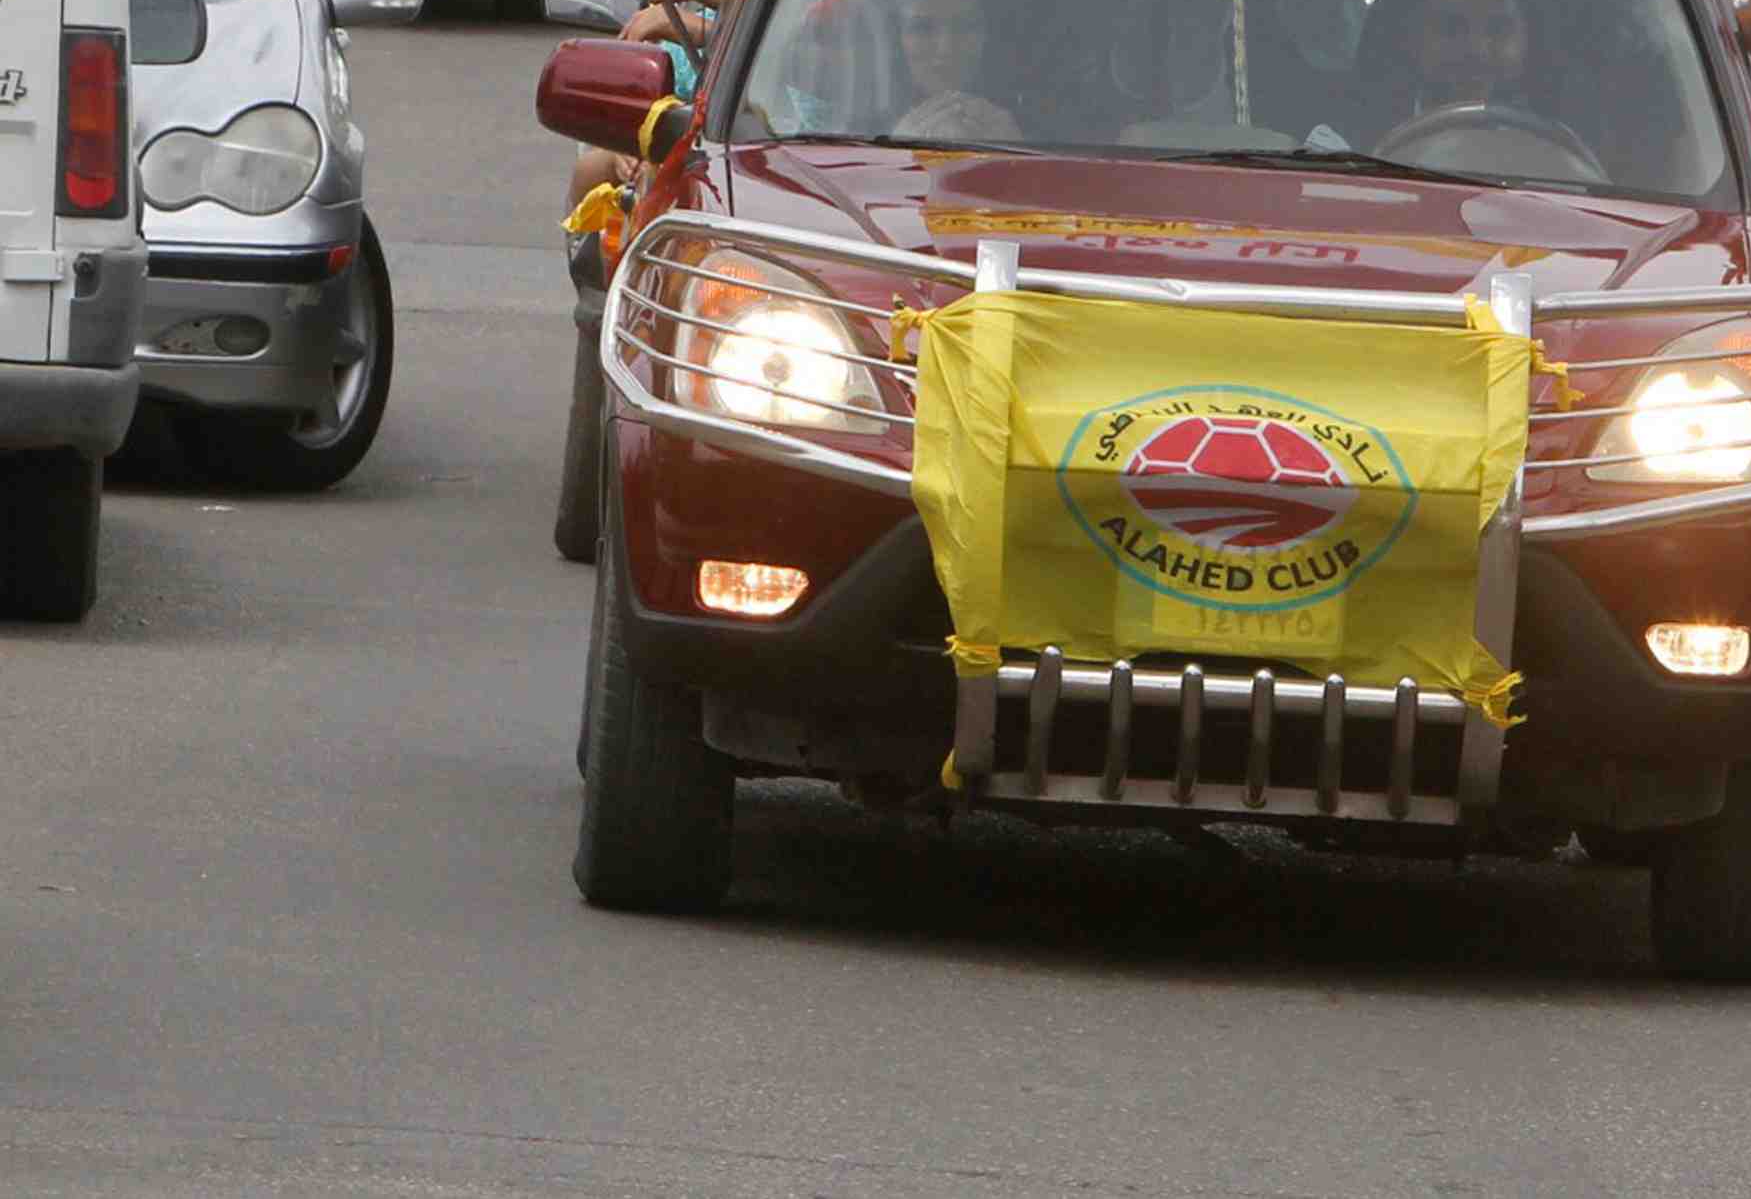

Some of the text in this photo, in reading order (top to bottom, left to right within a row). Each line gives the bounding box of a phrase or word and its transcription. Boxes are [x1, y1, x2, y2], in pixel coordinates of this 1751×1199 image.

[1312, 422, 1389, 483] نادي
[1100, 516, 1253, 591] ALAHED
[1266, 539, 1360, 591] CLUB
